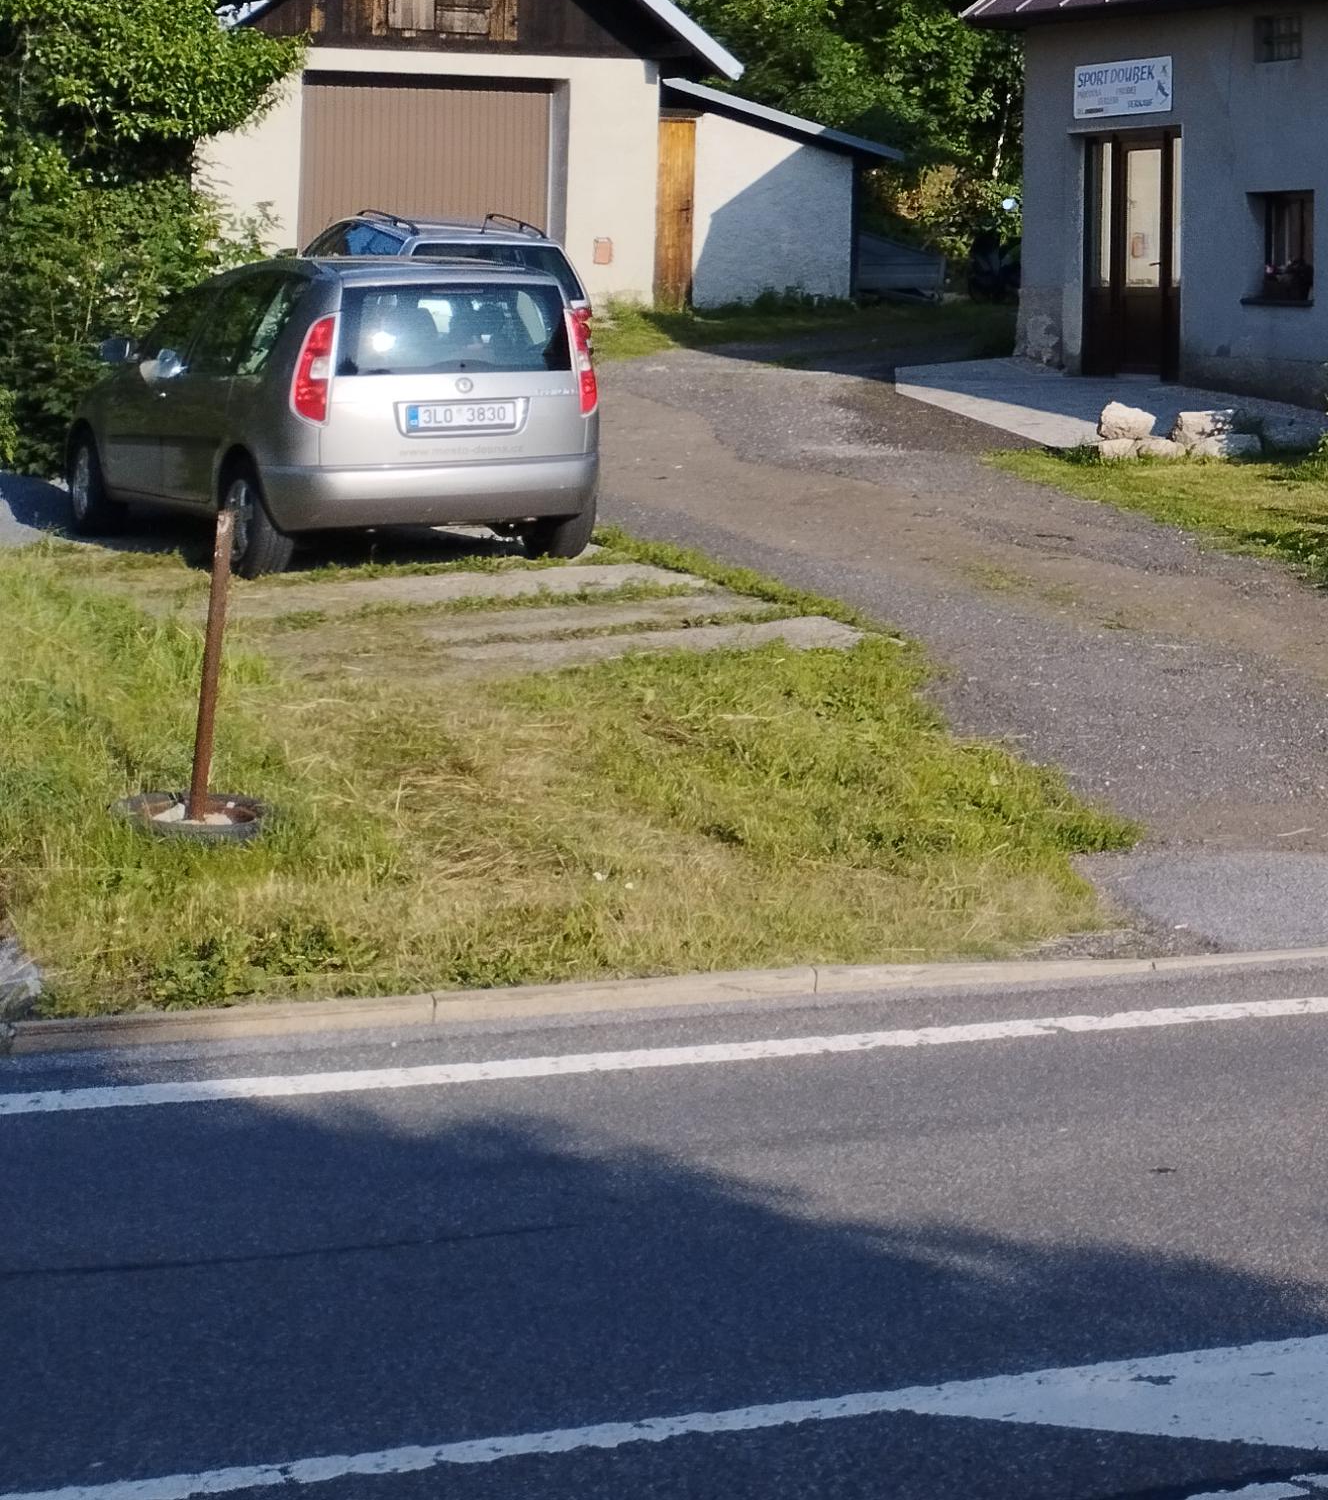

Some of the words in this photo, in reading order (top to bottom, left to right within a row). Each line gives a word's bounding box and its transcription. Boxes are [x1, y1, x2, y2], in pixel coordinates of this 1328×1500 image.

[1077, 69, 1109, 88] SPORT
[423, 408, 453, 424] 3L0
[466, 406, 506, 423] 3830
